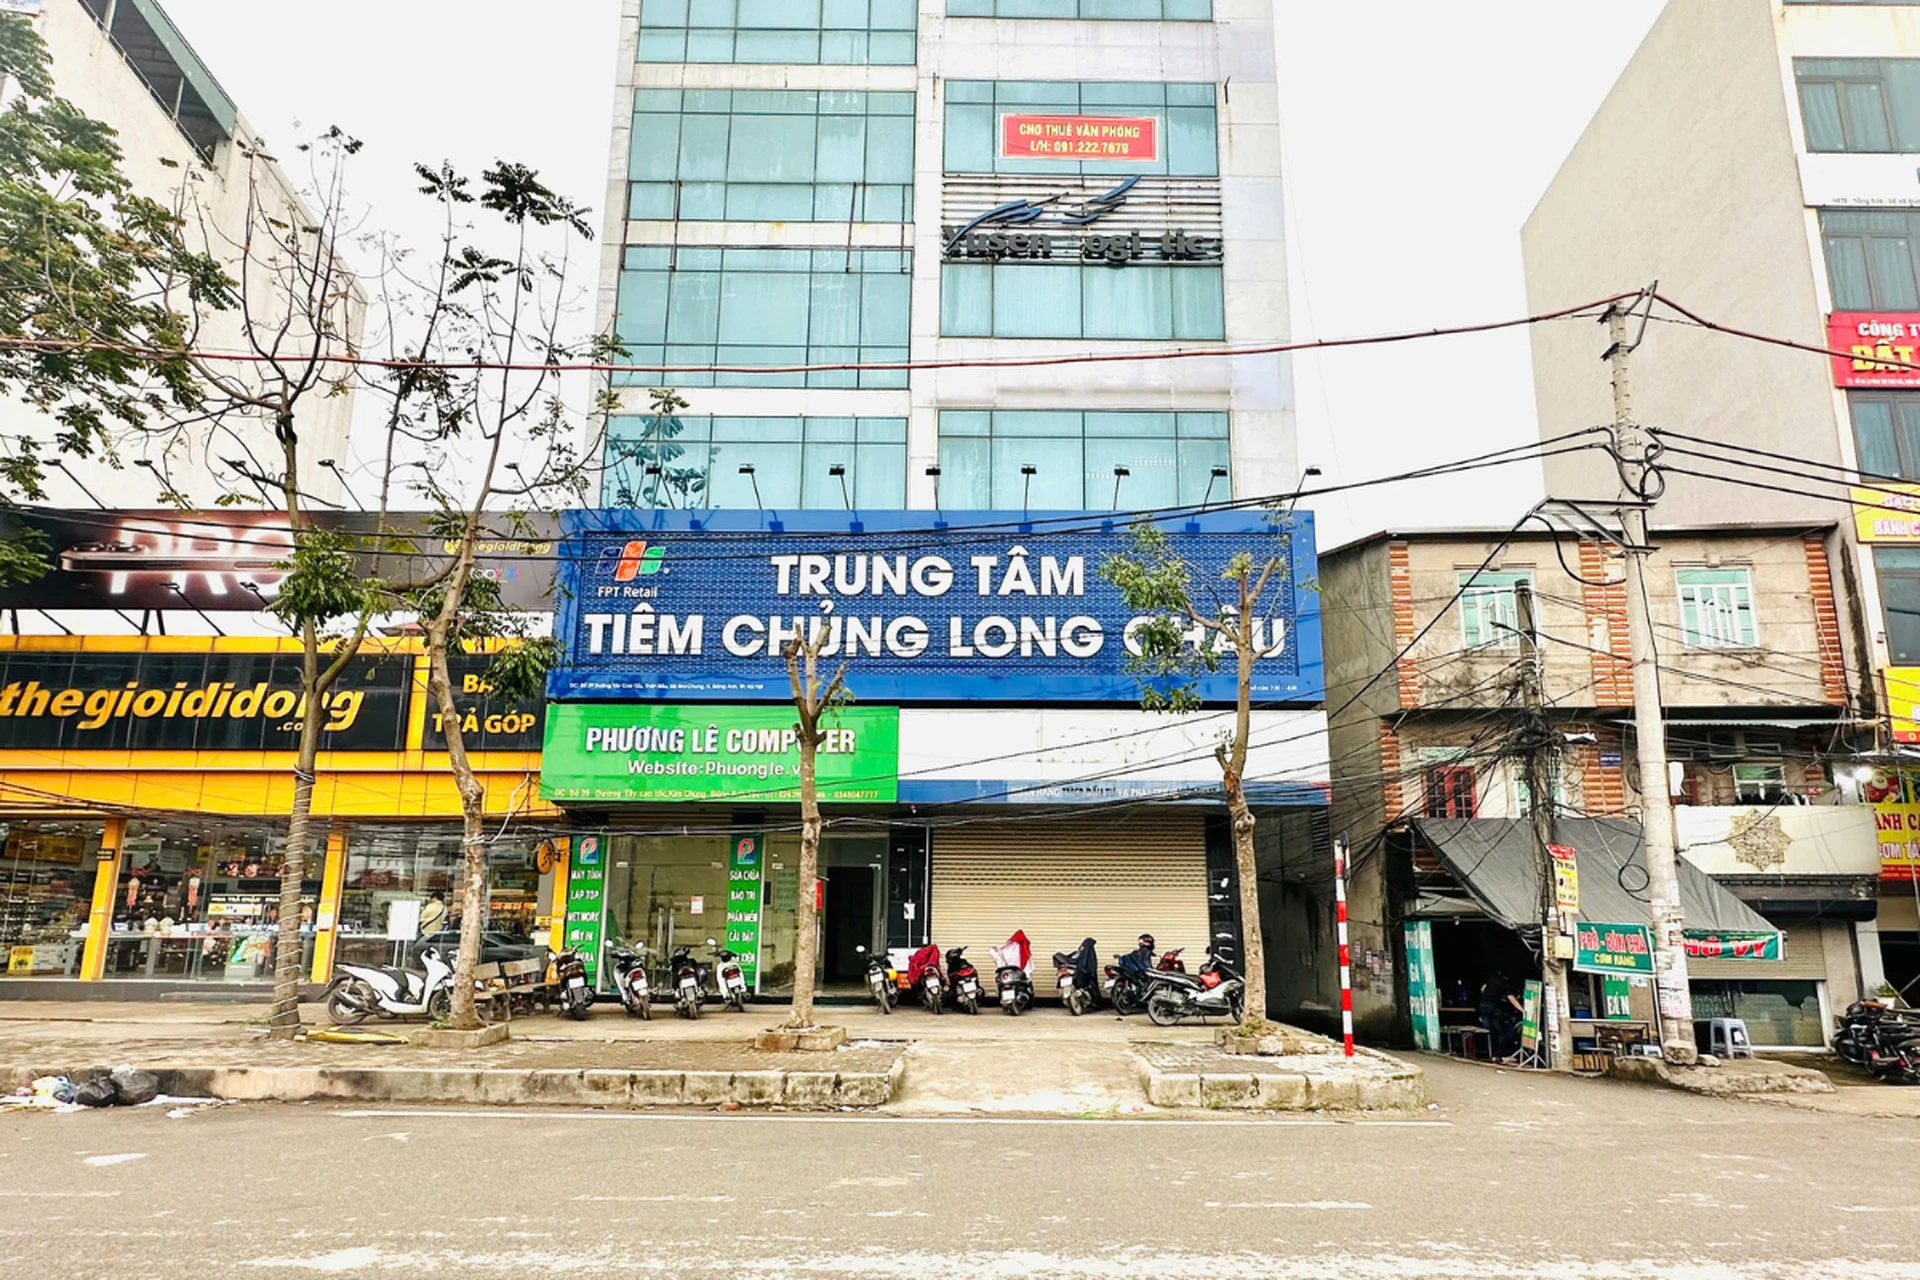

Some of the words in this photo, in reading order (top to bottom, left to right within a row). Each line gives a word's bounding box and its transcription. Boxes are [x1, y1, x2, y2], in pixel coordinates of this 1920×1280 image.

[1019, 123, 1042, 135] CHO
[1858, 320, 1904, 337] CÔNG
[771, 555, 954, 596] TRUNG
[971, 545, 1084, 596] TÂM
[598, 587, 620, 597] FPT
[623, 586, 658, 598] Retail
[584, 603, 704, 655] TIÊM
[722, 600, 929, 658] CHỦNG
[949, 616, 1104, 658] LONG
[276, 722, 304, 731] .co
[484, 709, 536, 733] GÓP
[586, 725, 684, 752] PHƯƠNG
[692, 724, 719, 753] LÊ
[571, 890, 583, 899] LAP
[586, 890, 598, 899] TOP
